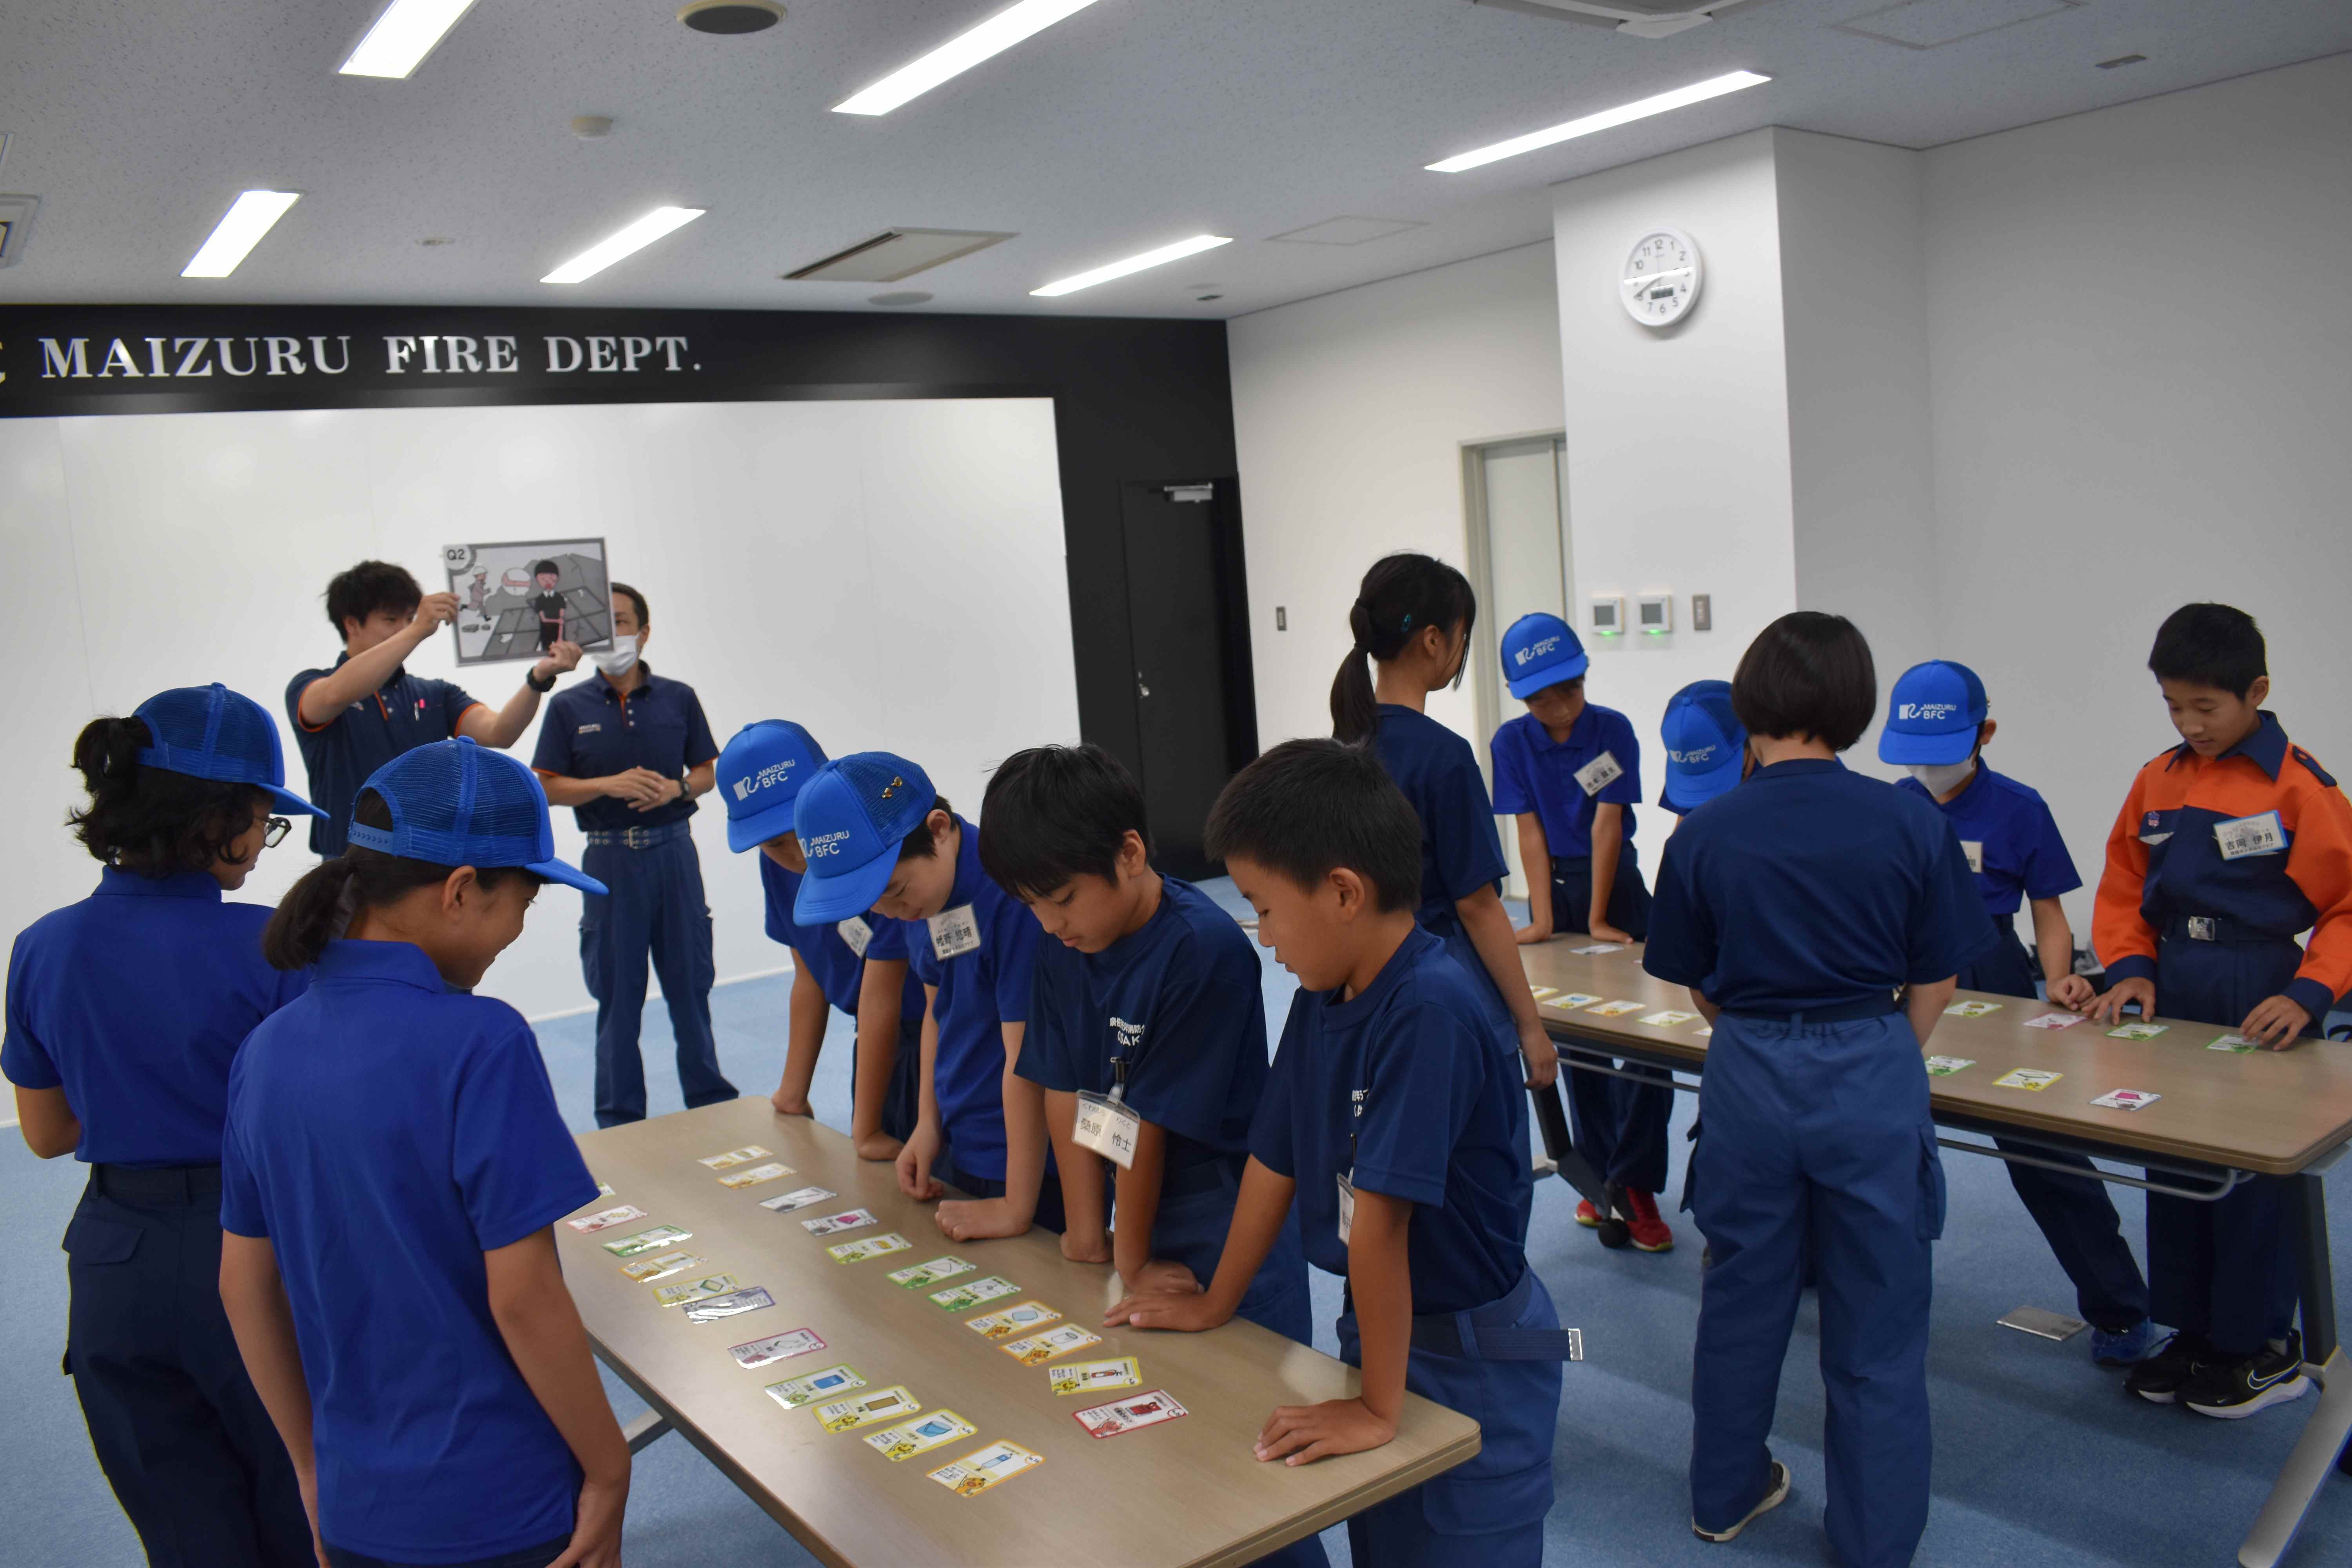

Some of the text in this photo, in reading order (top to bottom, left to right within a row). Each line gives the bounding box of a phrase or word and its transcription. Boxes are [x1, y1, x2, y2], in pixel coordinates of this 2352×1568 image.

[1679, 250, 1685, 261] 2
[1634, 260, 1644, 270] 10
[1659, 303, 1666, 314] 6
[39, 336, 351, 379] MAIZURU
[383, 335, 519, 374] FIRE
[544, 336, 702, 373] DEPT.
[447, 549, 465, 560] Q2
[1536, 643, 1555, 656] BFC
[1923, 710, 1945, 719] BFC
[758, 759, 795, 778] MAIZURU
[762, 771, 788, 788] BFC
[811, 830, 850, 845] MAIZURU
[2225, 838, 2247, 850] 吉岡
[2253, 832, 2273, 844] 伊月
[815, 842, 840, 857] BFC
